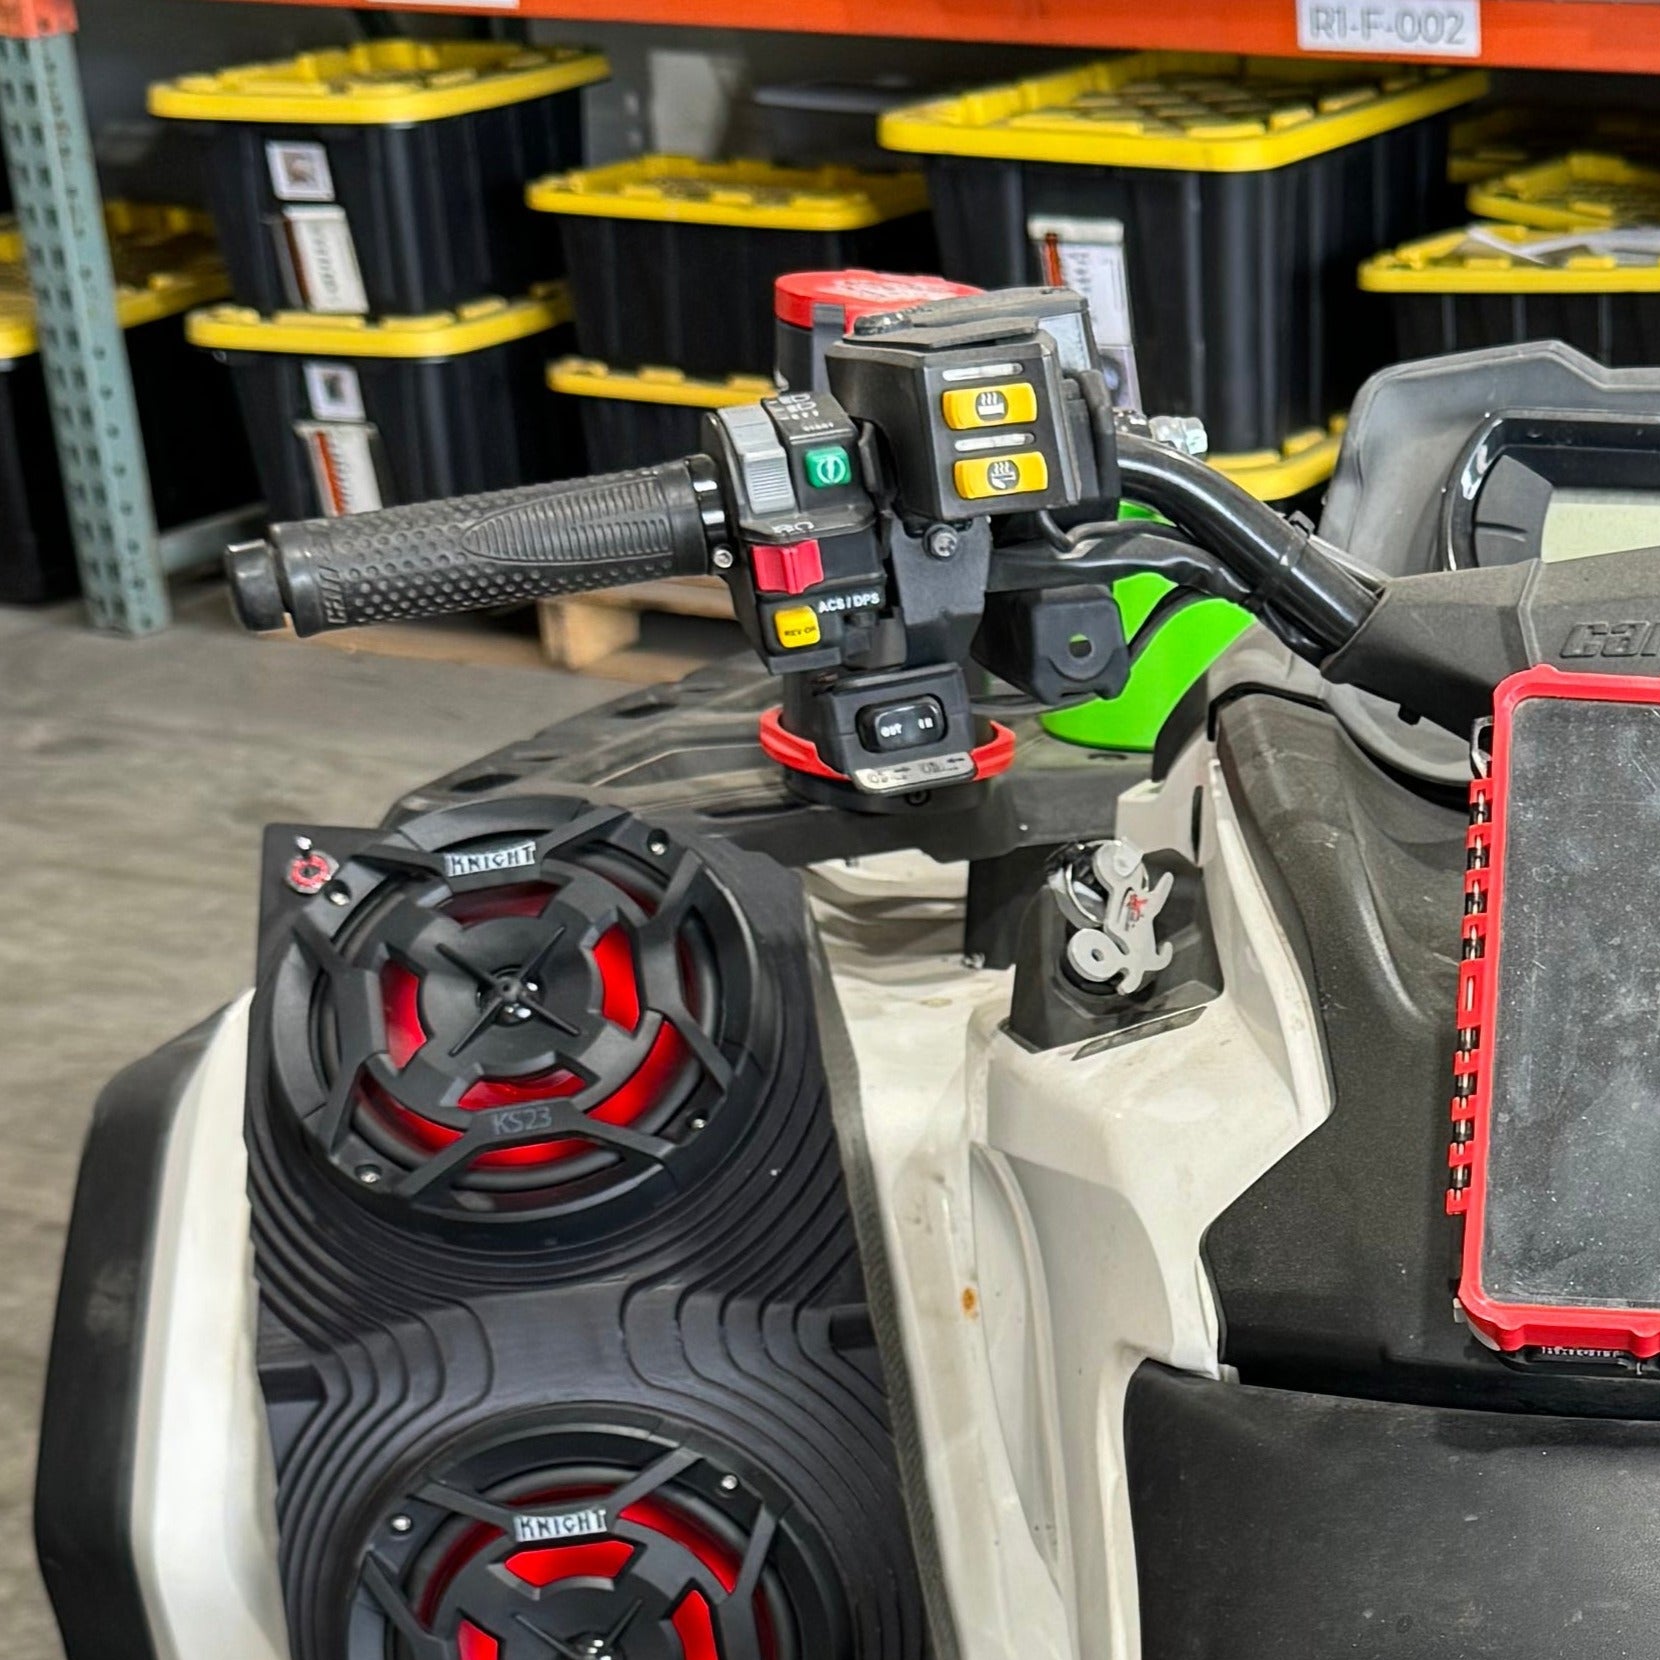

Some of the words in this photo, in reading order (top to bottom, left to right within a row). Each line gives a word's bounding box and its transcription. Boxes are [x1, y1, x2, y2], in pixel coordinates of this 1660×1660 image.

[1309, 6, 1466, 45] R1-F-002
[447, 843, 536, 875] KNIGHT
[492, 1106, 552, 1135] KS23
[517, 1509, 606, 1540] KNIGHT
